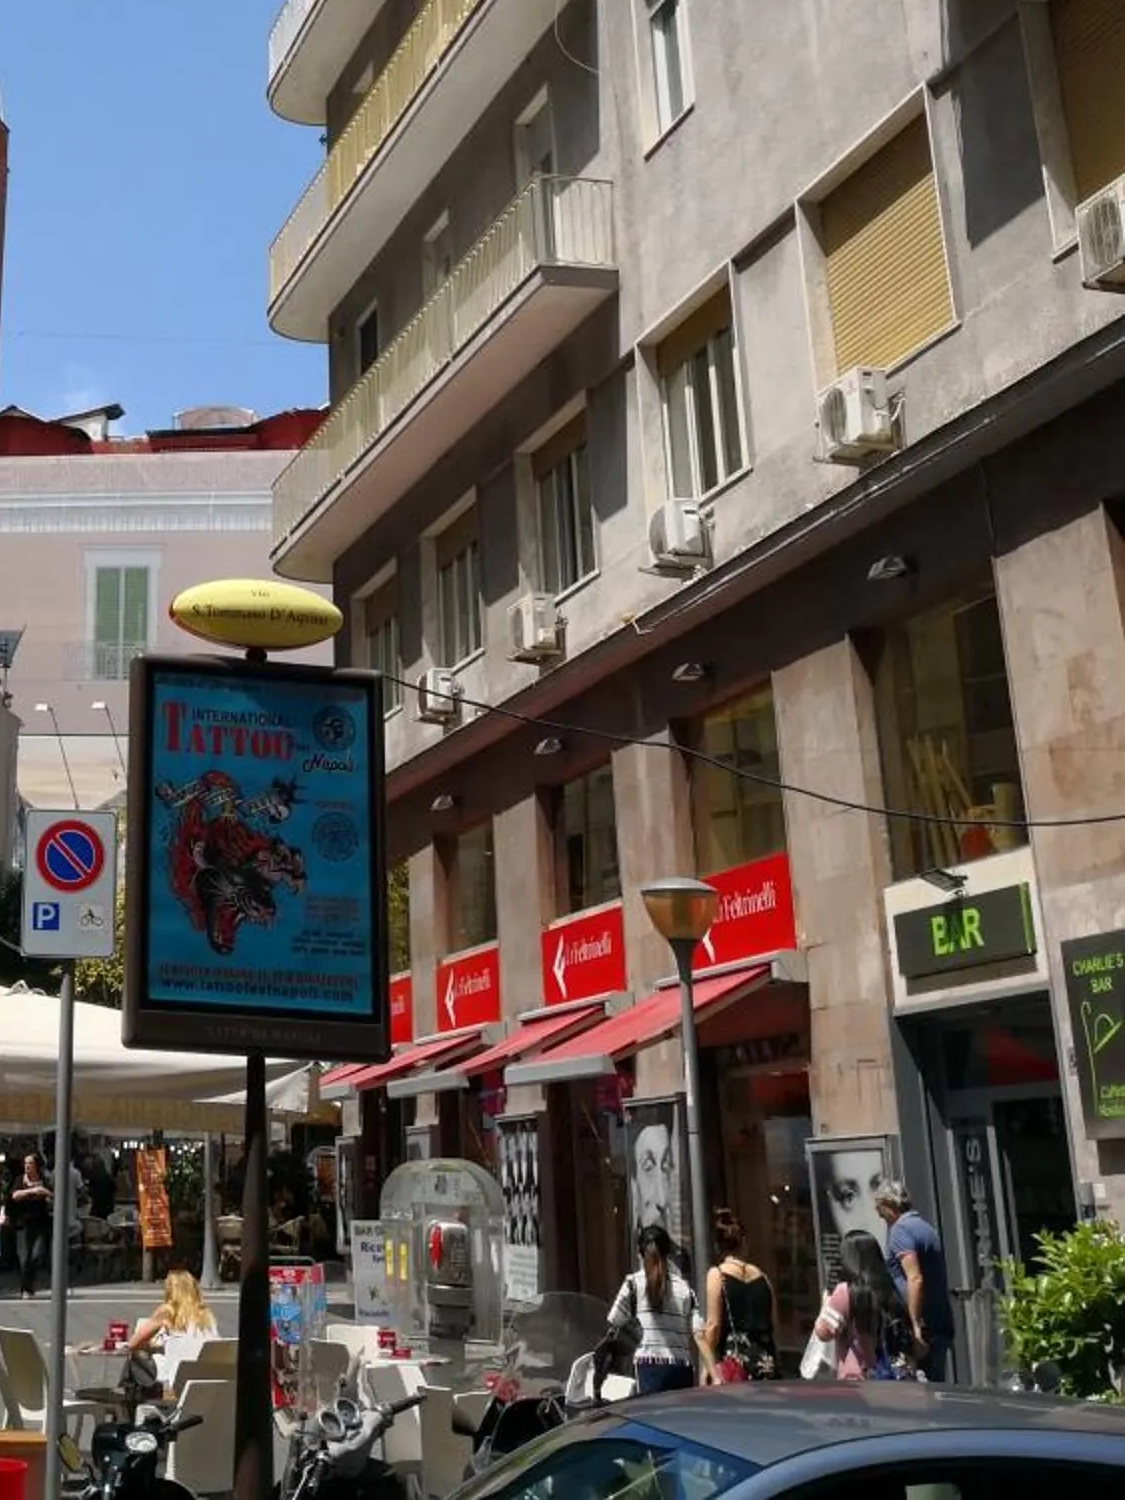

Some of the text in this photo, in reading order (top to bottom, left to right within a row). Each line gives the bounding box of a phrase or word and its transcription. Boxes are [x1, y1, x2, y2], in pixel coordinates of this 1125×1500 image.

[161, 701, 295, 761] TATTOO
[36, 903, 56, 929] P
[723, 880, 777, 922] Feltrinelli
[930, 907, 985, 956] BAR
[1090, 977, 1114, 994] BAR
